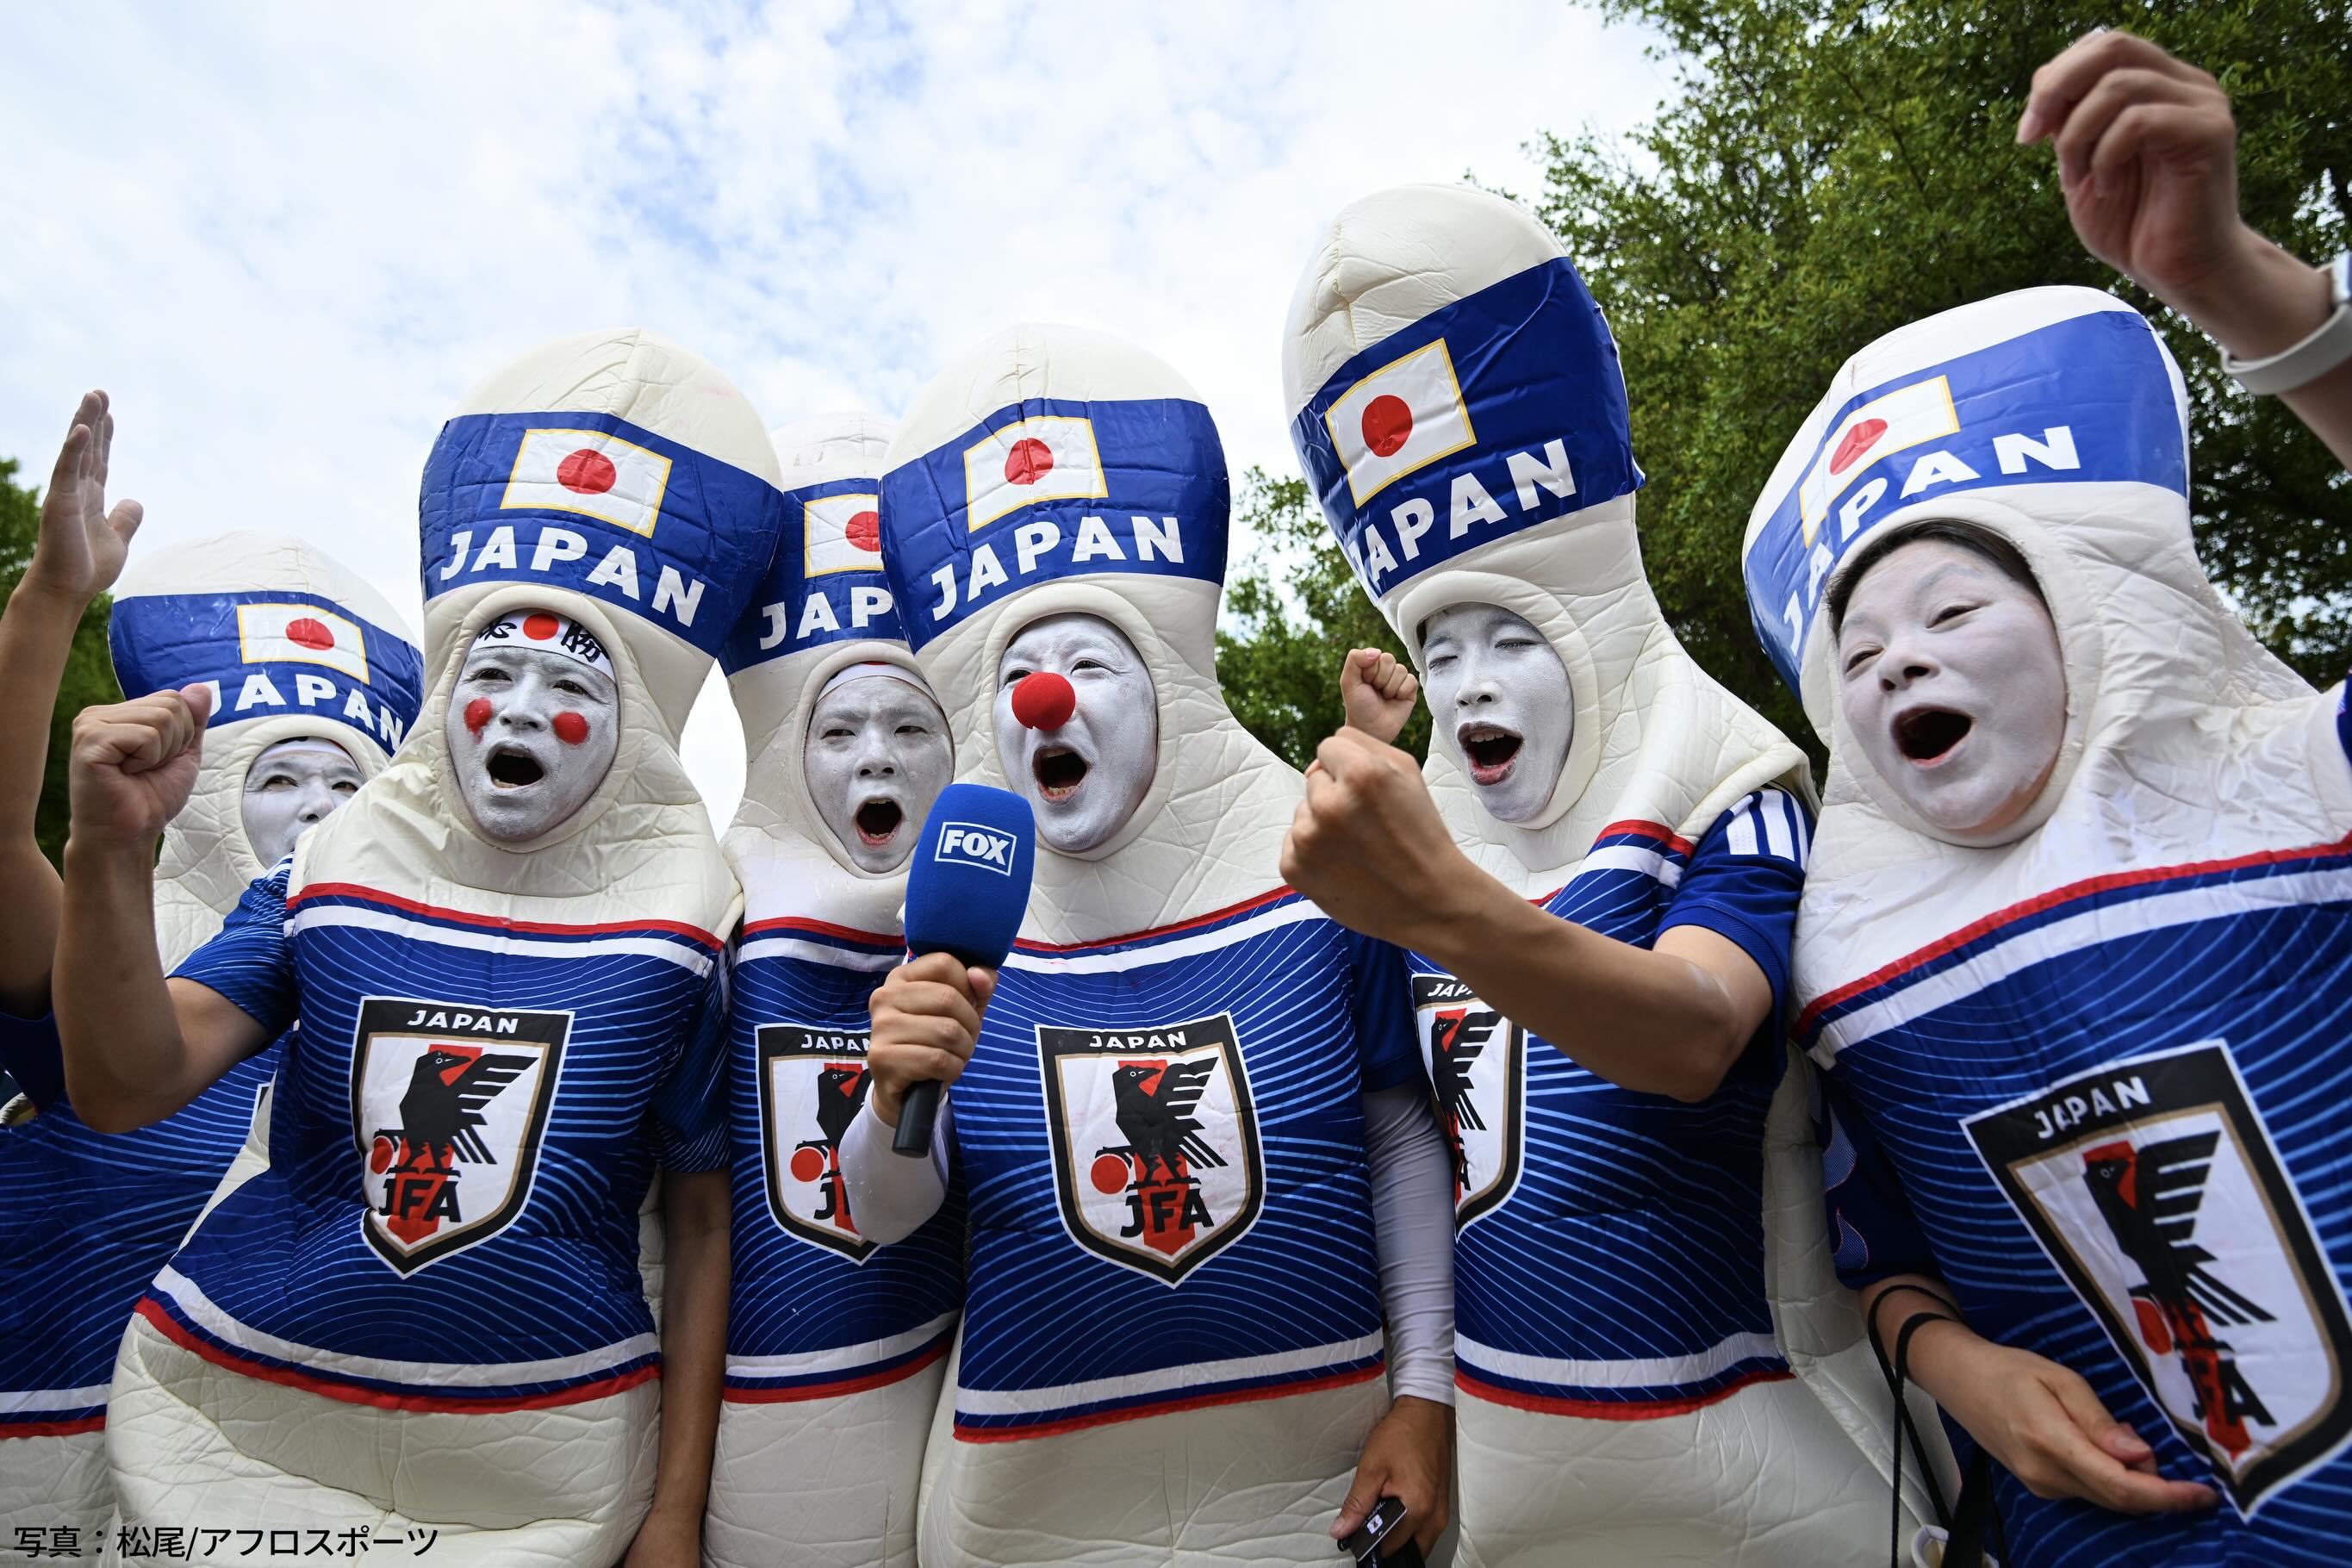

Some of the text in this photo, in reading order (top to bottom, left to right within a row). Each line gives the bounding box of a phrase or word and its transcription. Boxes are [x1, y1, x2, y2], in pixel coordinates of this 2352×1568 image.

[1347, 438, 1577, 593] JAPAN
[1783, 425, 2081, 657] JAPAN
[440, 526, 705, 627] JAPAN
[930, 516, 1185, 621] JAPAN
[759, 586, 893, 650] JAP
[943, 829, 1010, 866] FOX
[1427, 983, 1473, 997] JAP
[407, 1009, 520, 1034] JAPAN
[1089, 1031, 1187, 1048] JAPAN
[2034, 1076, 2151, 1139] JAPAN
[379, 1179, 462, 1223] JFA
[1120, 1189, 1215, 1238] JFA
